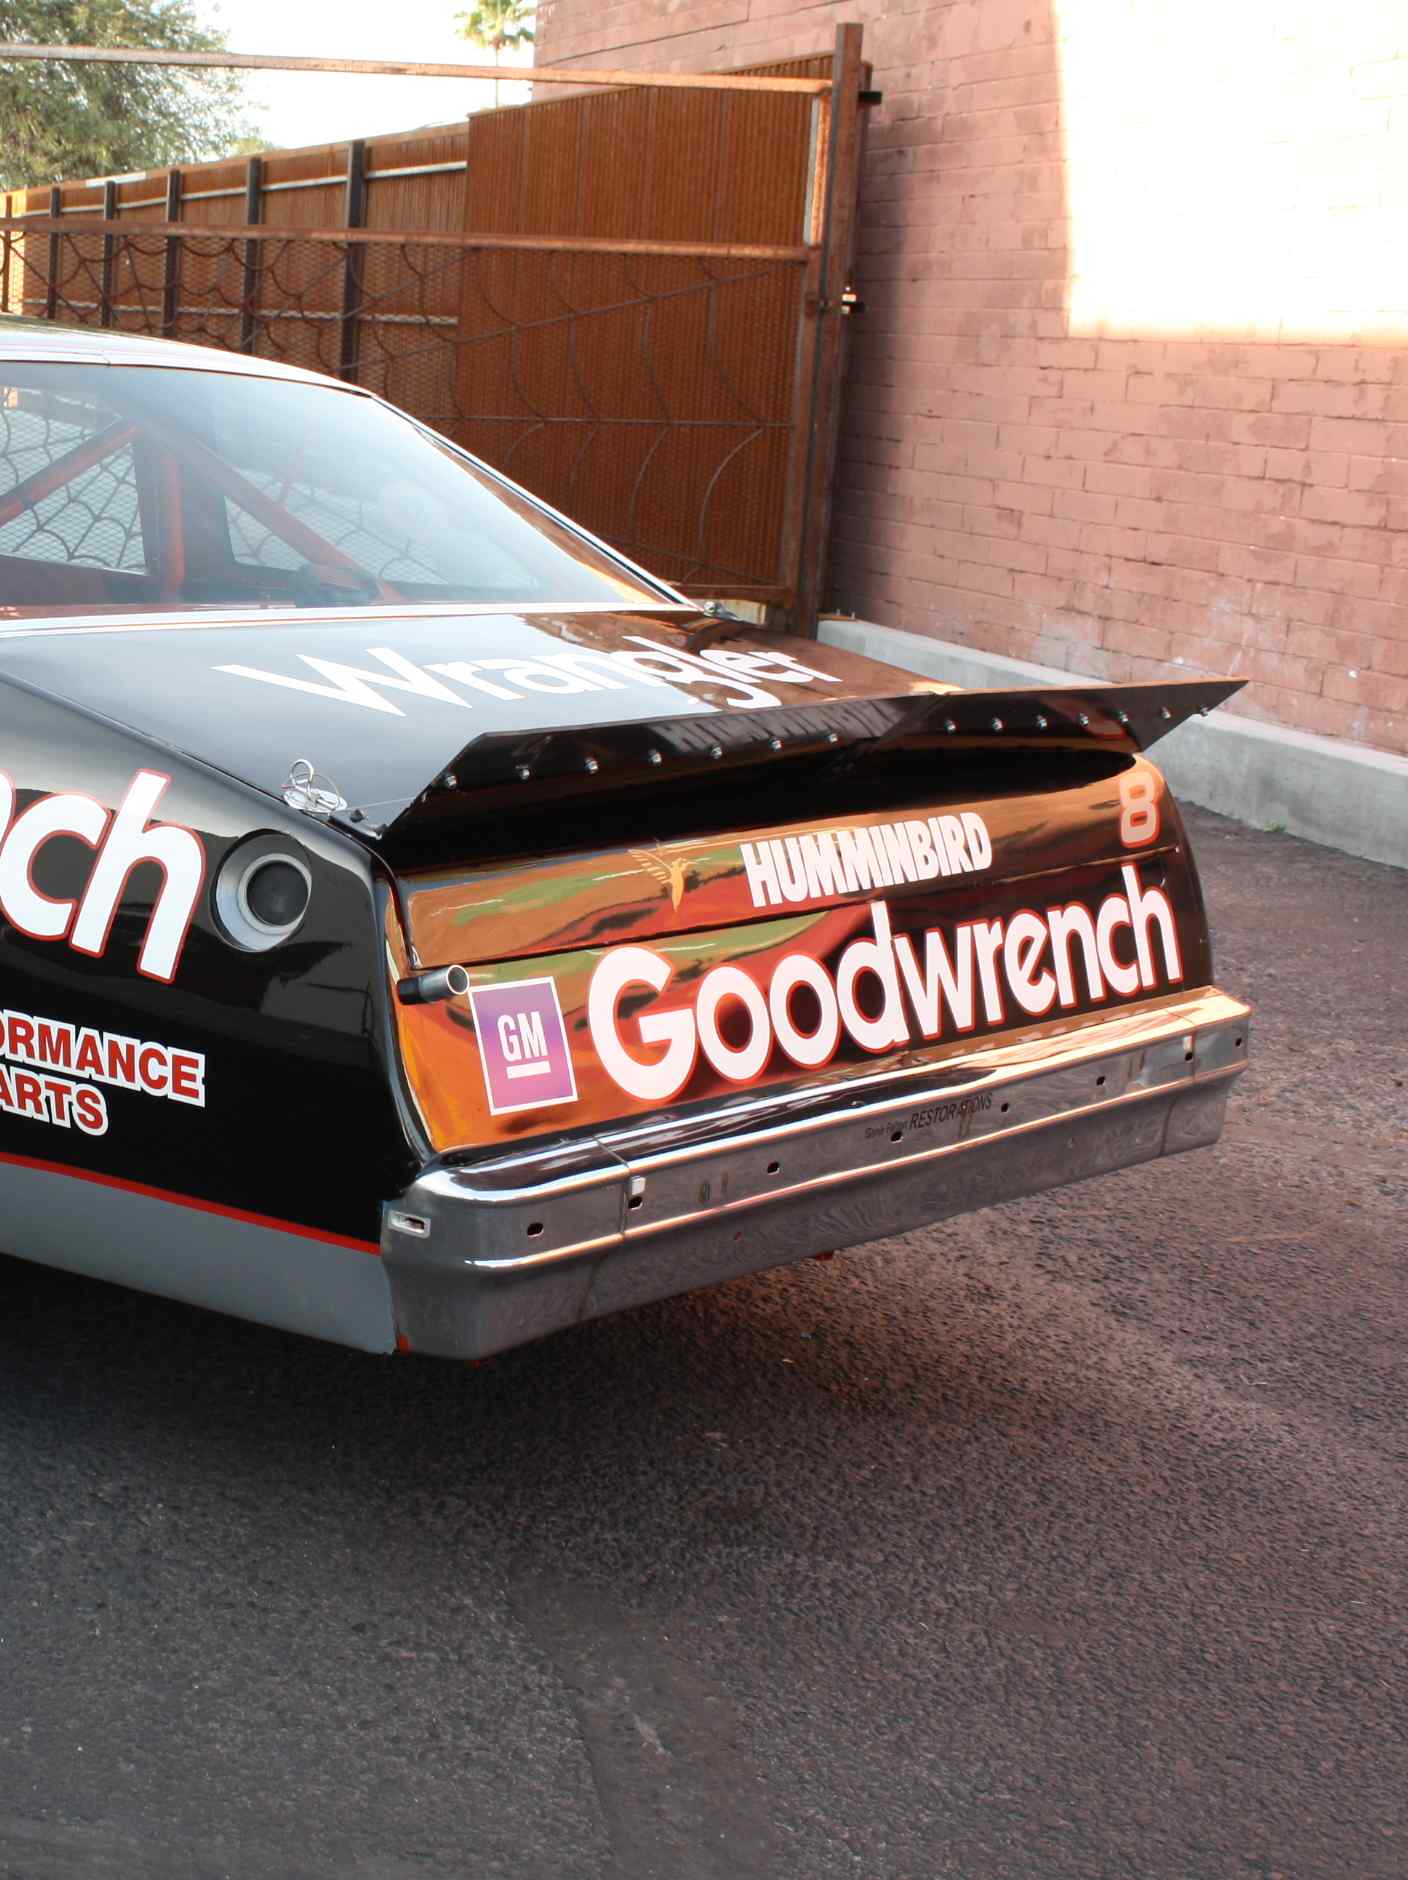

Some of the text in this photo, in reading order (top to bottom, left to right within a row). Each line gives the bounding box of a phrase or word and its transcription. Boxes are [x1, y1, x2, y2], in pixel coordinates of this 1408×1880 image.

[210, 634, 843, 717] Wrangler
[1118, 769, 1160, 849] 8
[739, 811, 993, 909] HUMMINBIRD
[587, 863, 1184, 1104] Goodwrench
[496, 1010, 549, 1063] GM
